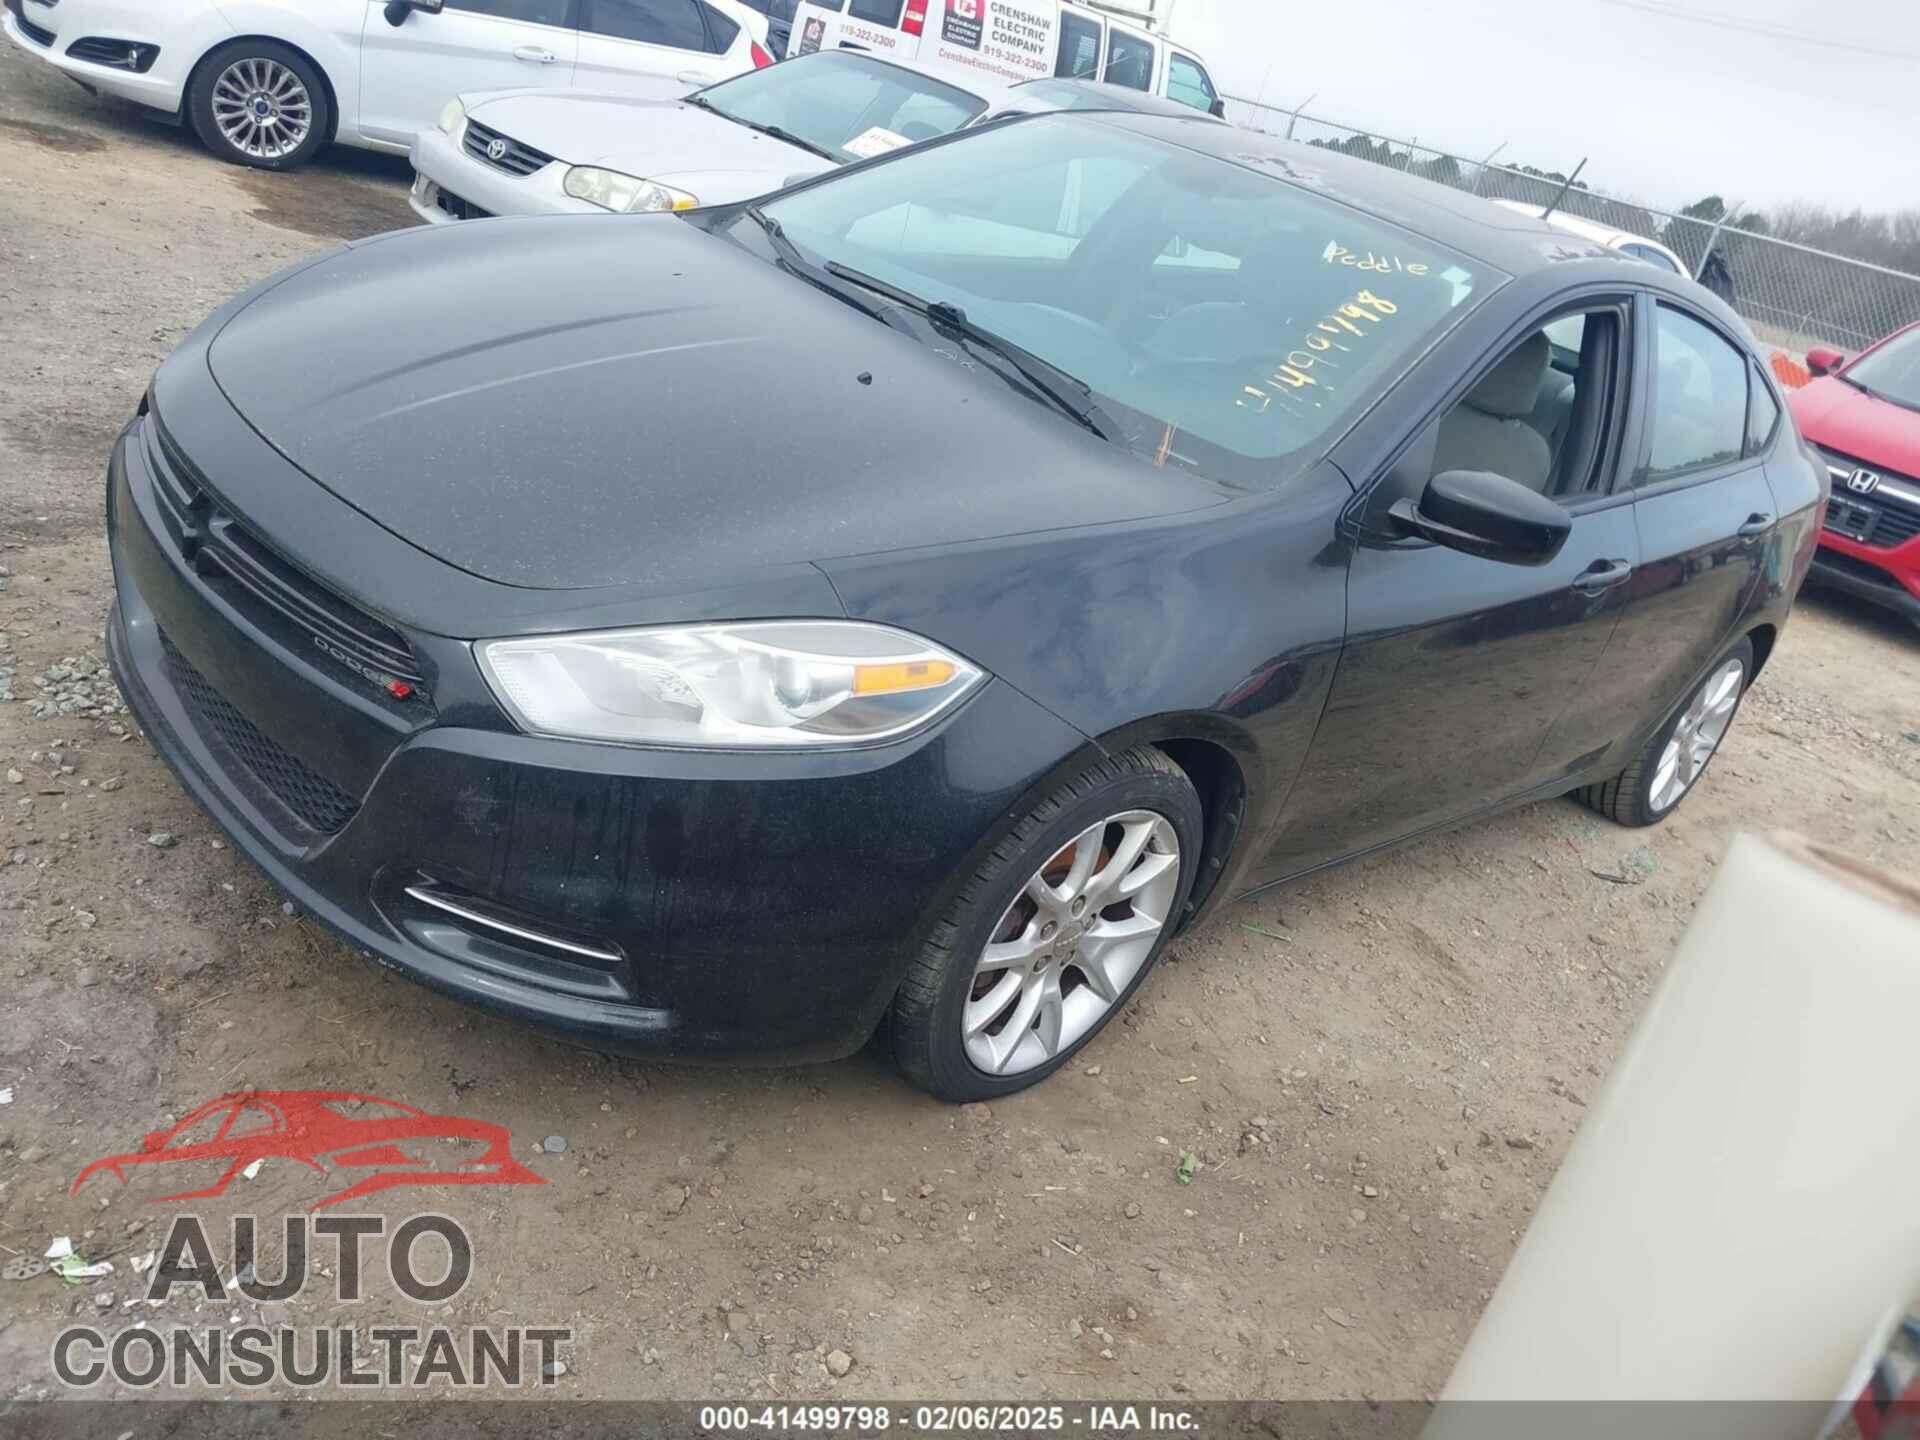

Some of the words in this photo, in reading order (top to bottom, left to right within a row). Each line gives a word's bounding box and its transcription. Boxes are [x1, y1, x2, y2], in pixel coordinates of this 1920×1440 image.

[990, 1, 1051, 31] CRENSHAW
[993, 17, 1046, 42] ELECTRIC
[991, 30, 1044, 55] COMPANY
